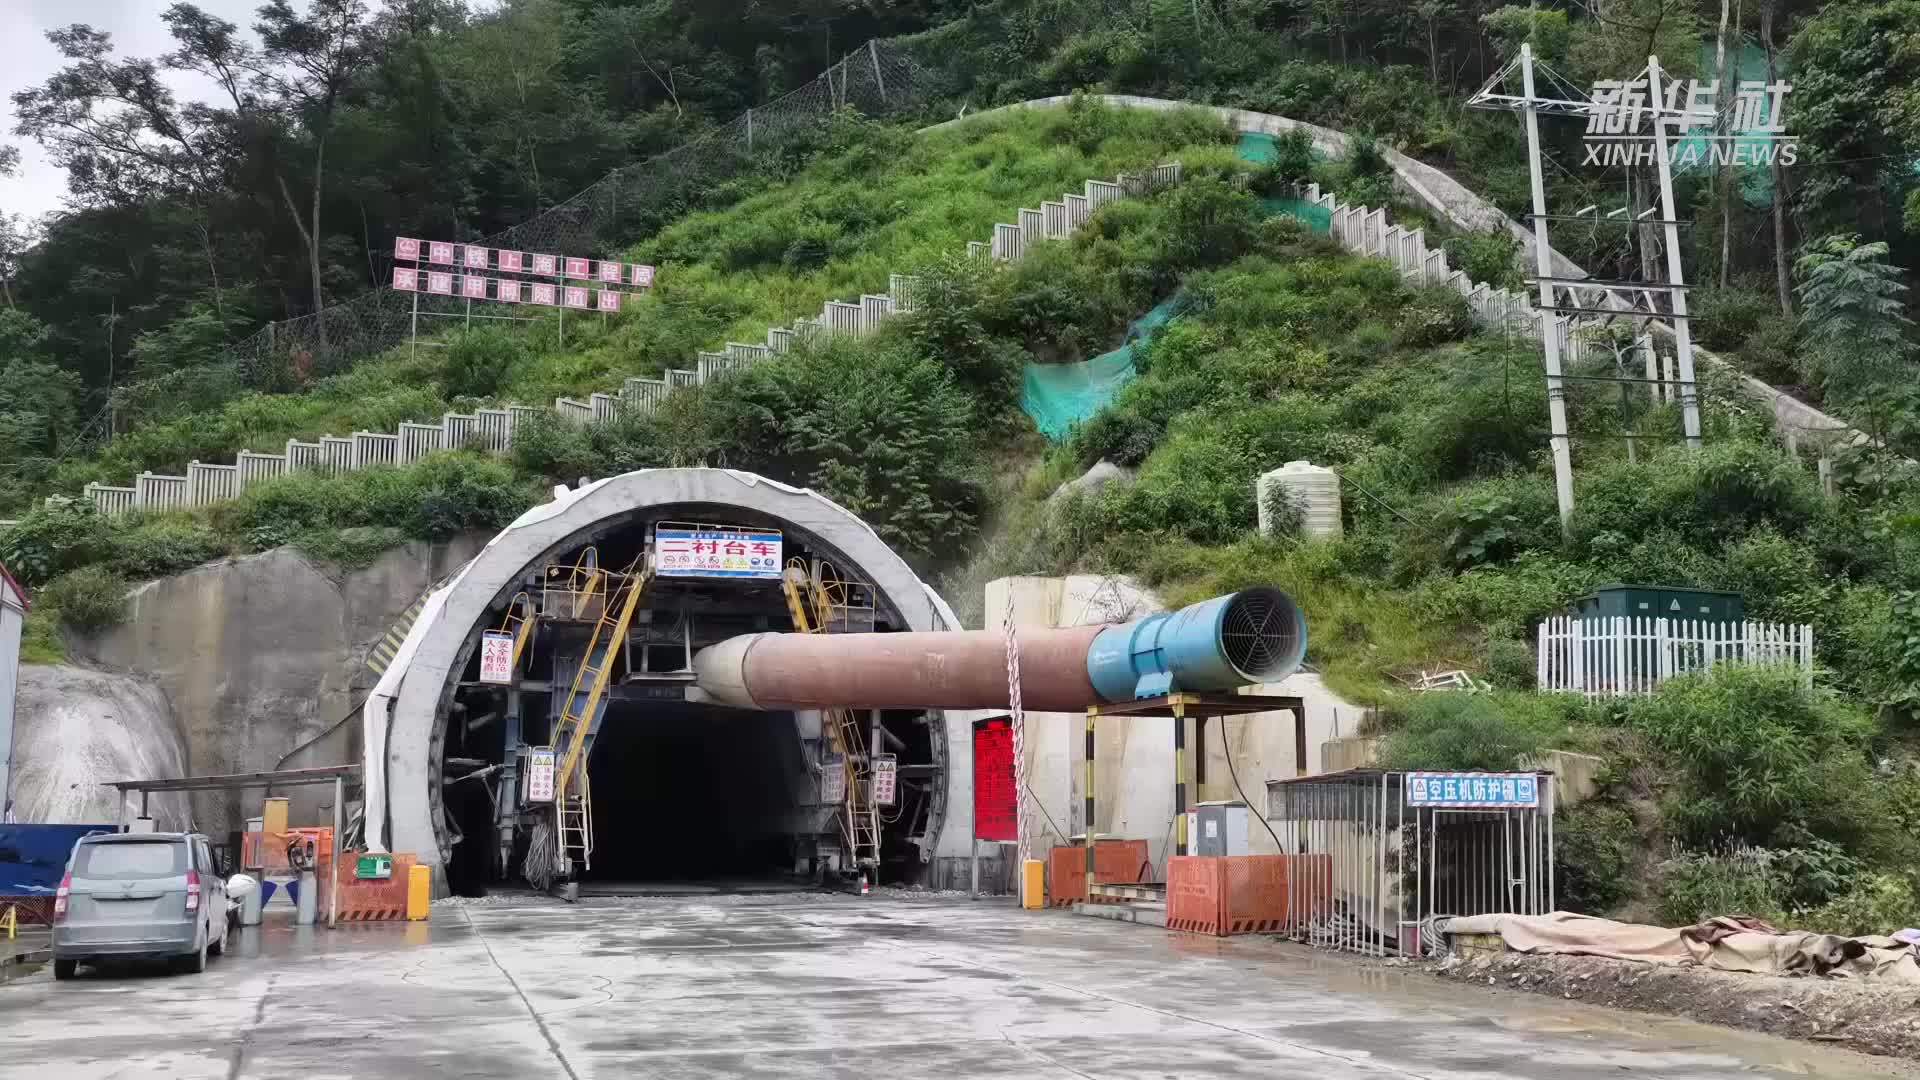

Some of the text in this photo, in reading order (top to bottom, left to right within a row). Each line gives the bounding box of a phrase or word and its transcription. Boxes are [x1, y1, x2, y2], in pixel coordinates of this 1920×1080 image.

[432, 245, 652, 286] 中铁上海工程局
[662, 540, 777, 556] 二衬台车
[484, 639, 495, 672] 人人有责
[496, 640, 508, 672] 安全防范
[1429, 778, 1515, 801] 空压机防护棚
